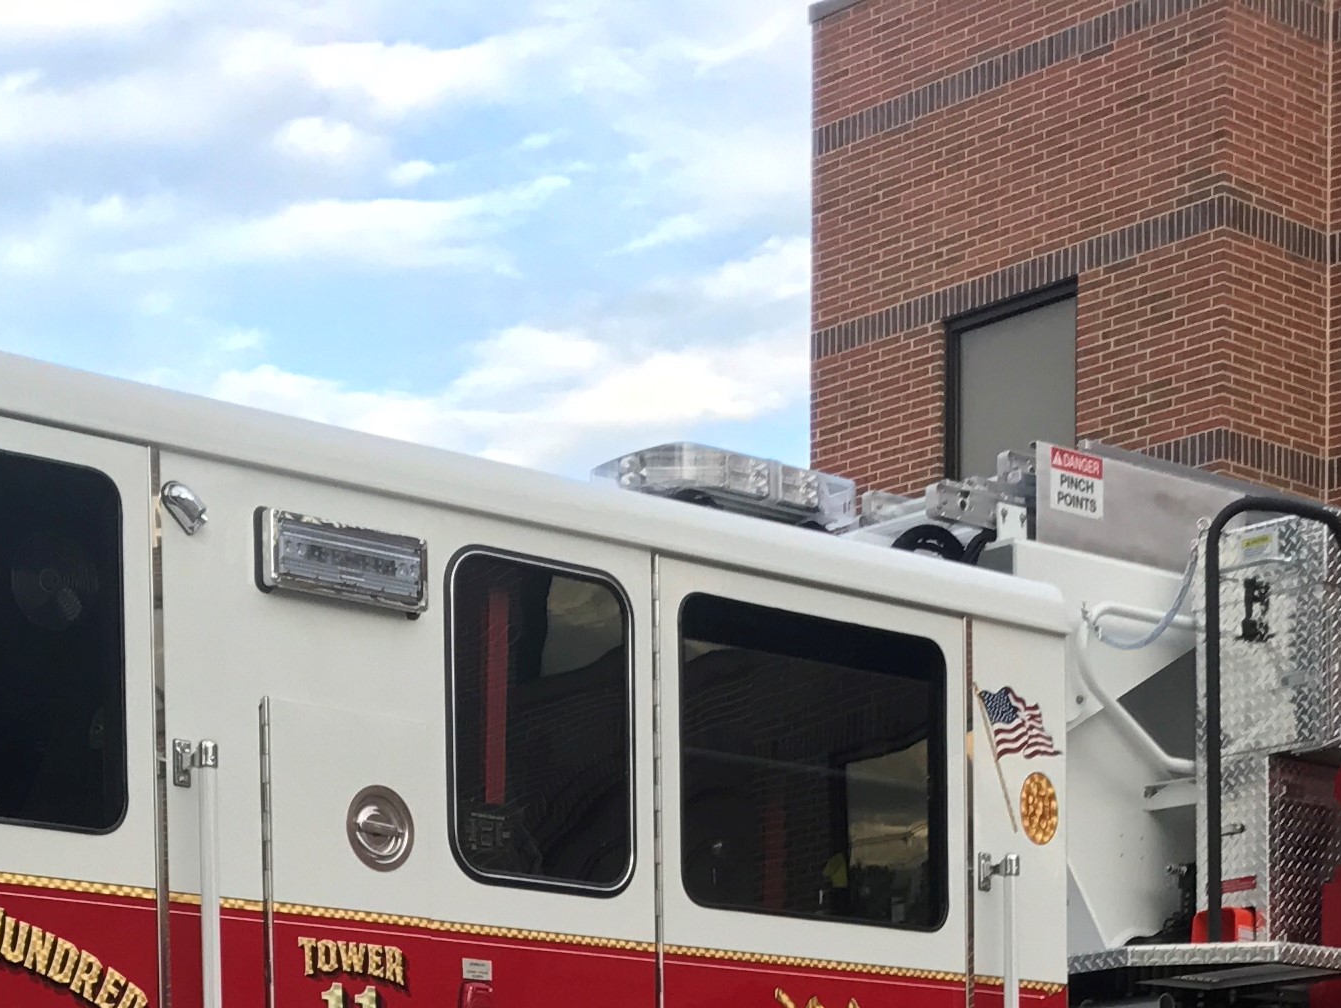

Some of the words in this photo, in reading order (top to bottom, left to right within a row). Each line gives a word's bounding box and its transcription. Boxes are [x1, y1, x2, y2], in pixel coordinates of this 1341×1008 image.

[1063, 453, 1100, 475] DANGER
[1060, 474, 1094, 494] PINCH
[1057, 491, 1097, 512] POINTS
[298, 936, 405, 986] TOWER
